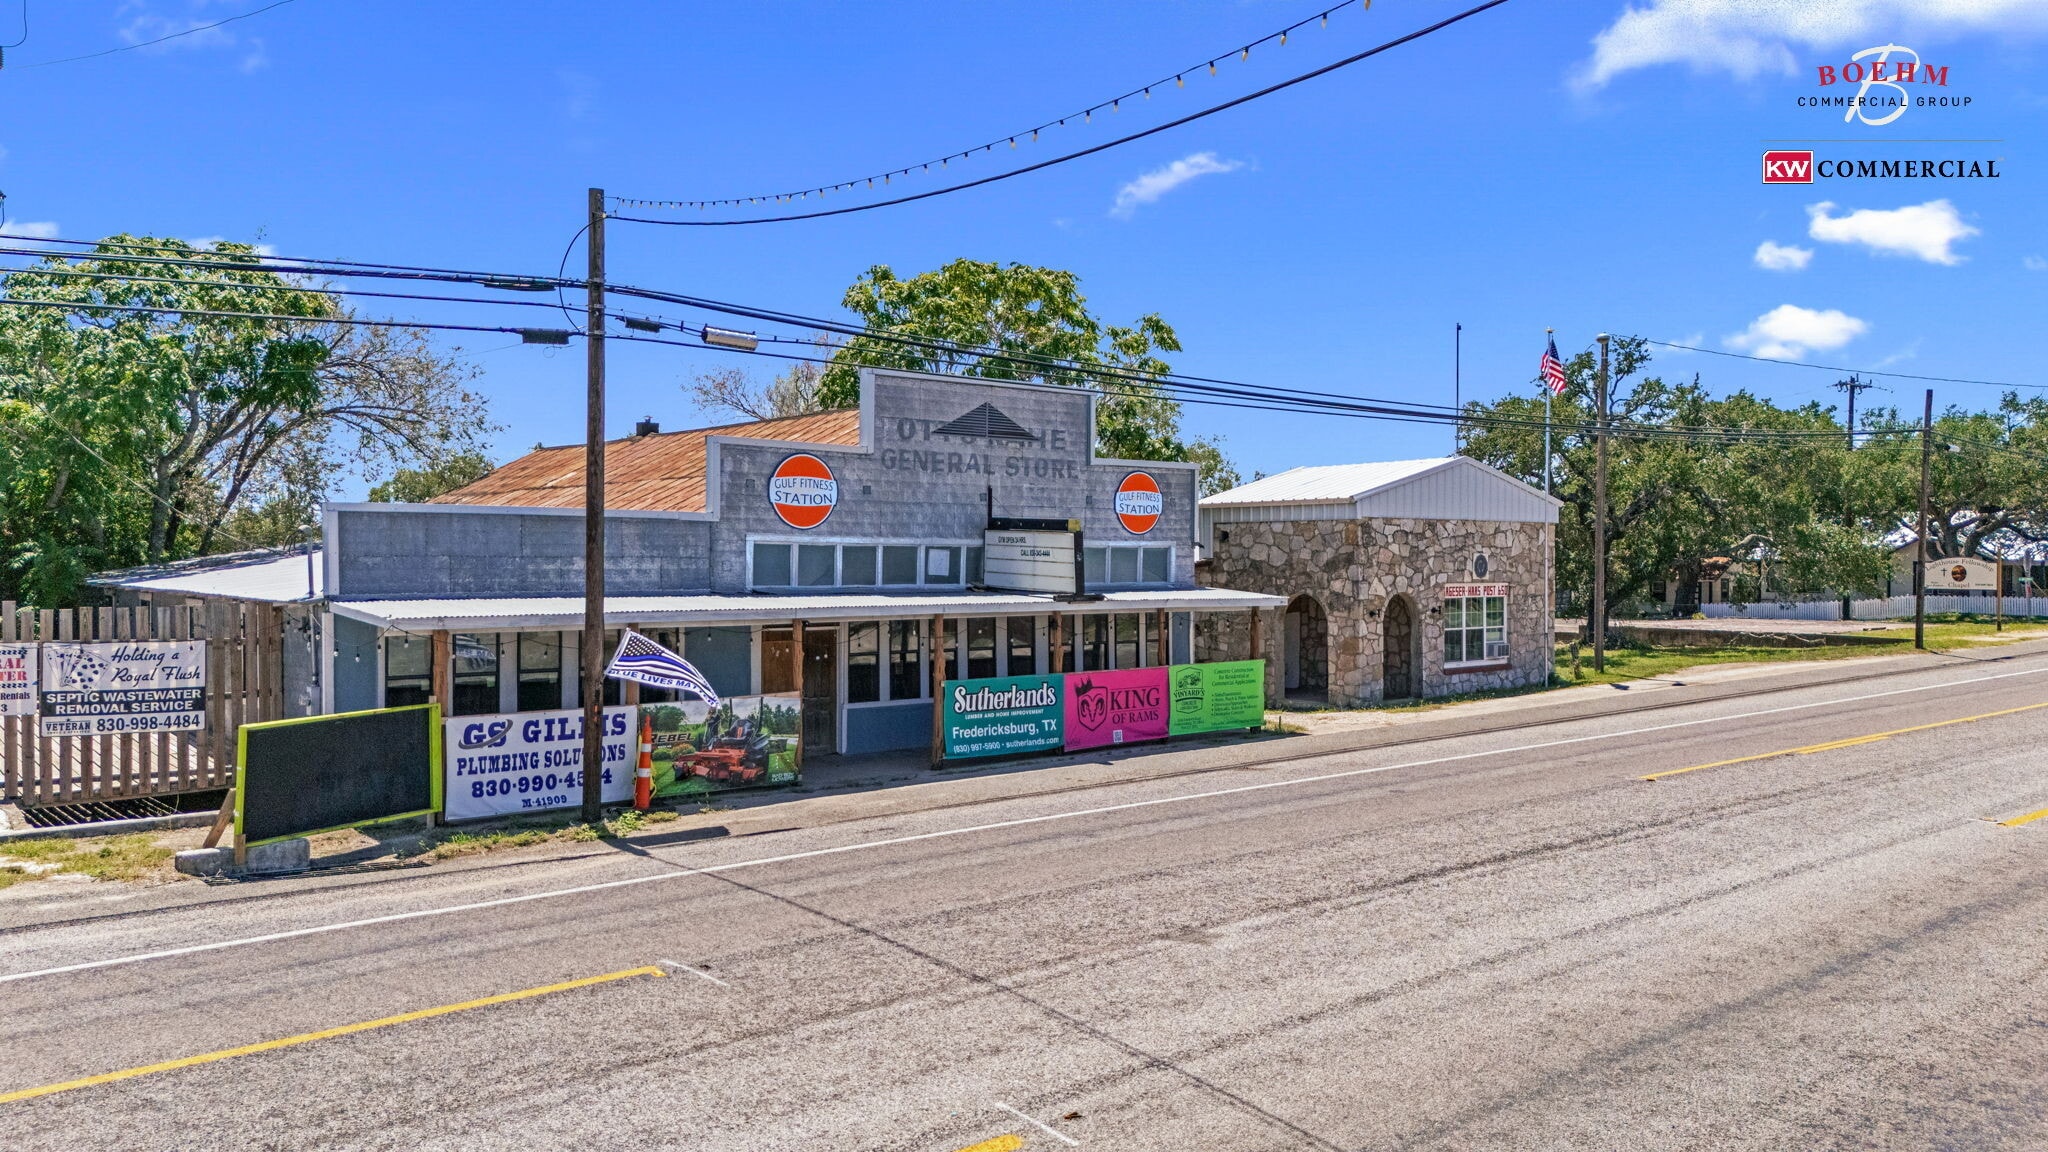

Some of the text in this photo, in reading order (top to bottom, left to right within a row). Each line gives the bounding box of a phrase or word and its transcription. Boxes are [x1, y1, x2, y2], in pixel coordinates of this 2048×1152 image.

[880, 448, 1079, 479] GENERAL STORE
[774, 477, 834, 492] GULF FITNESS
[774, 490, 833, 505] STATION
[1118, 492, 1160, 503] GULF FITNESS
[1119, 502, 1160, 514] STATION
[1483, 585, 1496, 596] POST
[0, 658, 25, 669] AL
[111, 645, 180, 667] Holding a
[110, 665, 201, 688] Royal Flush
[641, 673, 674, 686] LIVES
[0, 692, 31, 700] Rentals
[46, 689, 202, 704] SEPTIC WASTEWATER
[954, 682, 1057, 713] Sutherlands
[1110, 687, 1160, 711] KING
[1173, 689, 1205, 699] VINYARD'S
[55, 700, 193, 715] REMOVAL SERVICE
[1010, 709, 1044, 717] IMPROVEMENT
[96, 714, 201, 732] 830-998-4484
[1112, 710, 1160, 725] OF RAMS
[45, 722, 91, 731] VETERAN
[952, 719, 1057, 739] Fredericksburg, TX
[463, 721, 507, 748] GS
[651, 733, 694, 744] REBEL
[953, 744, 970, 754] (830)
[1006, 737, 1060, 748] sutherlands.com
[456, 743, 626, 776] PLUMBING SOLUNS
